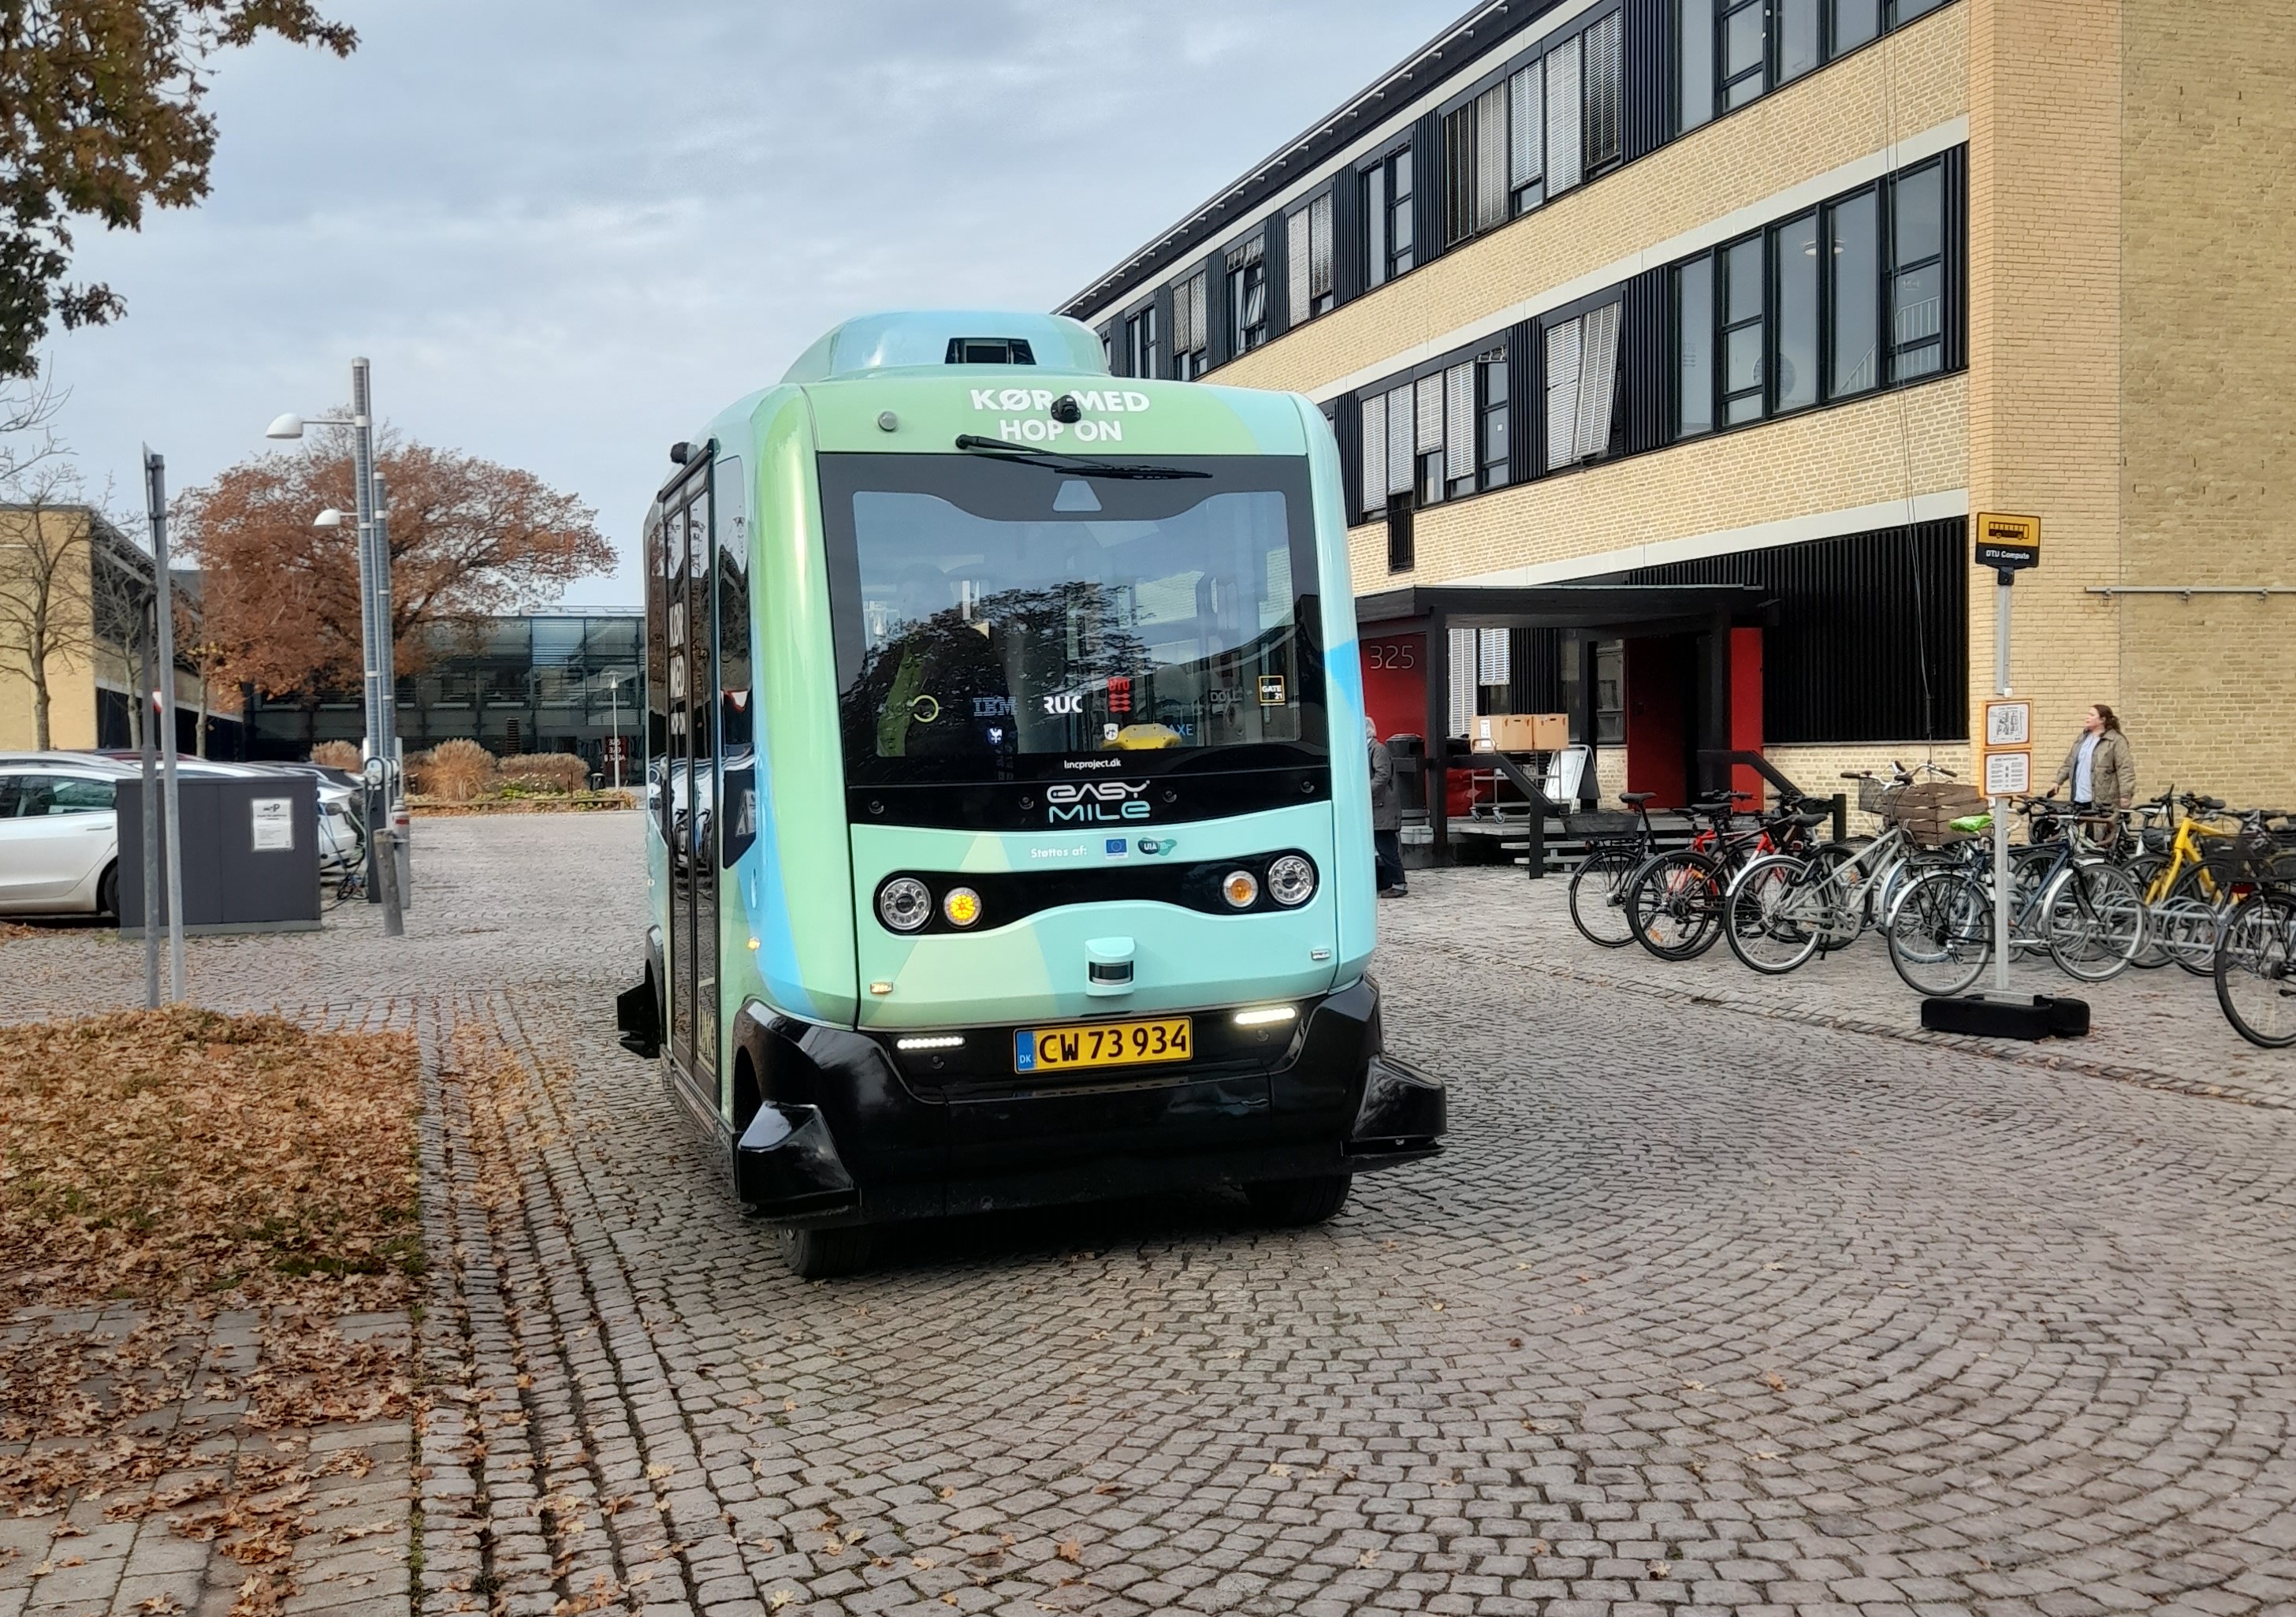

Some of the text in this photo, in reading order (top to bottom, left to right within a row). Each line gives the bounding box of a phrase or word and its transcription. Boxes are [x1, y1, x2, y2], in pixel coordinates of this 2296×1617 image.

[970, 389, 1150, 412] KØR MED
[999, 419, 1122, 442] HOP ON
[1370, 645, 1415, 669] 325
[1108, 676, 1130, 691] DTU
[973, 696, 1018, 717] IBM
[1044, 695, 1083, 713] RUC
[1064, 758, 1122, 770] lincproject.dk
[1031, 845, 1088, 859] Støttes af:
[1039, 1024, 1186, 1063] CW 73 934
[1019, 1054, 1032, 1064] DK
